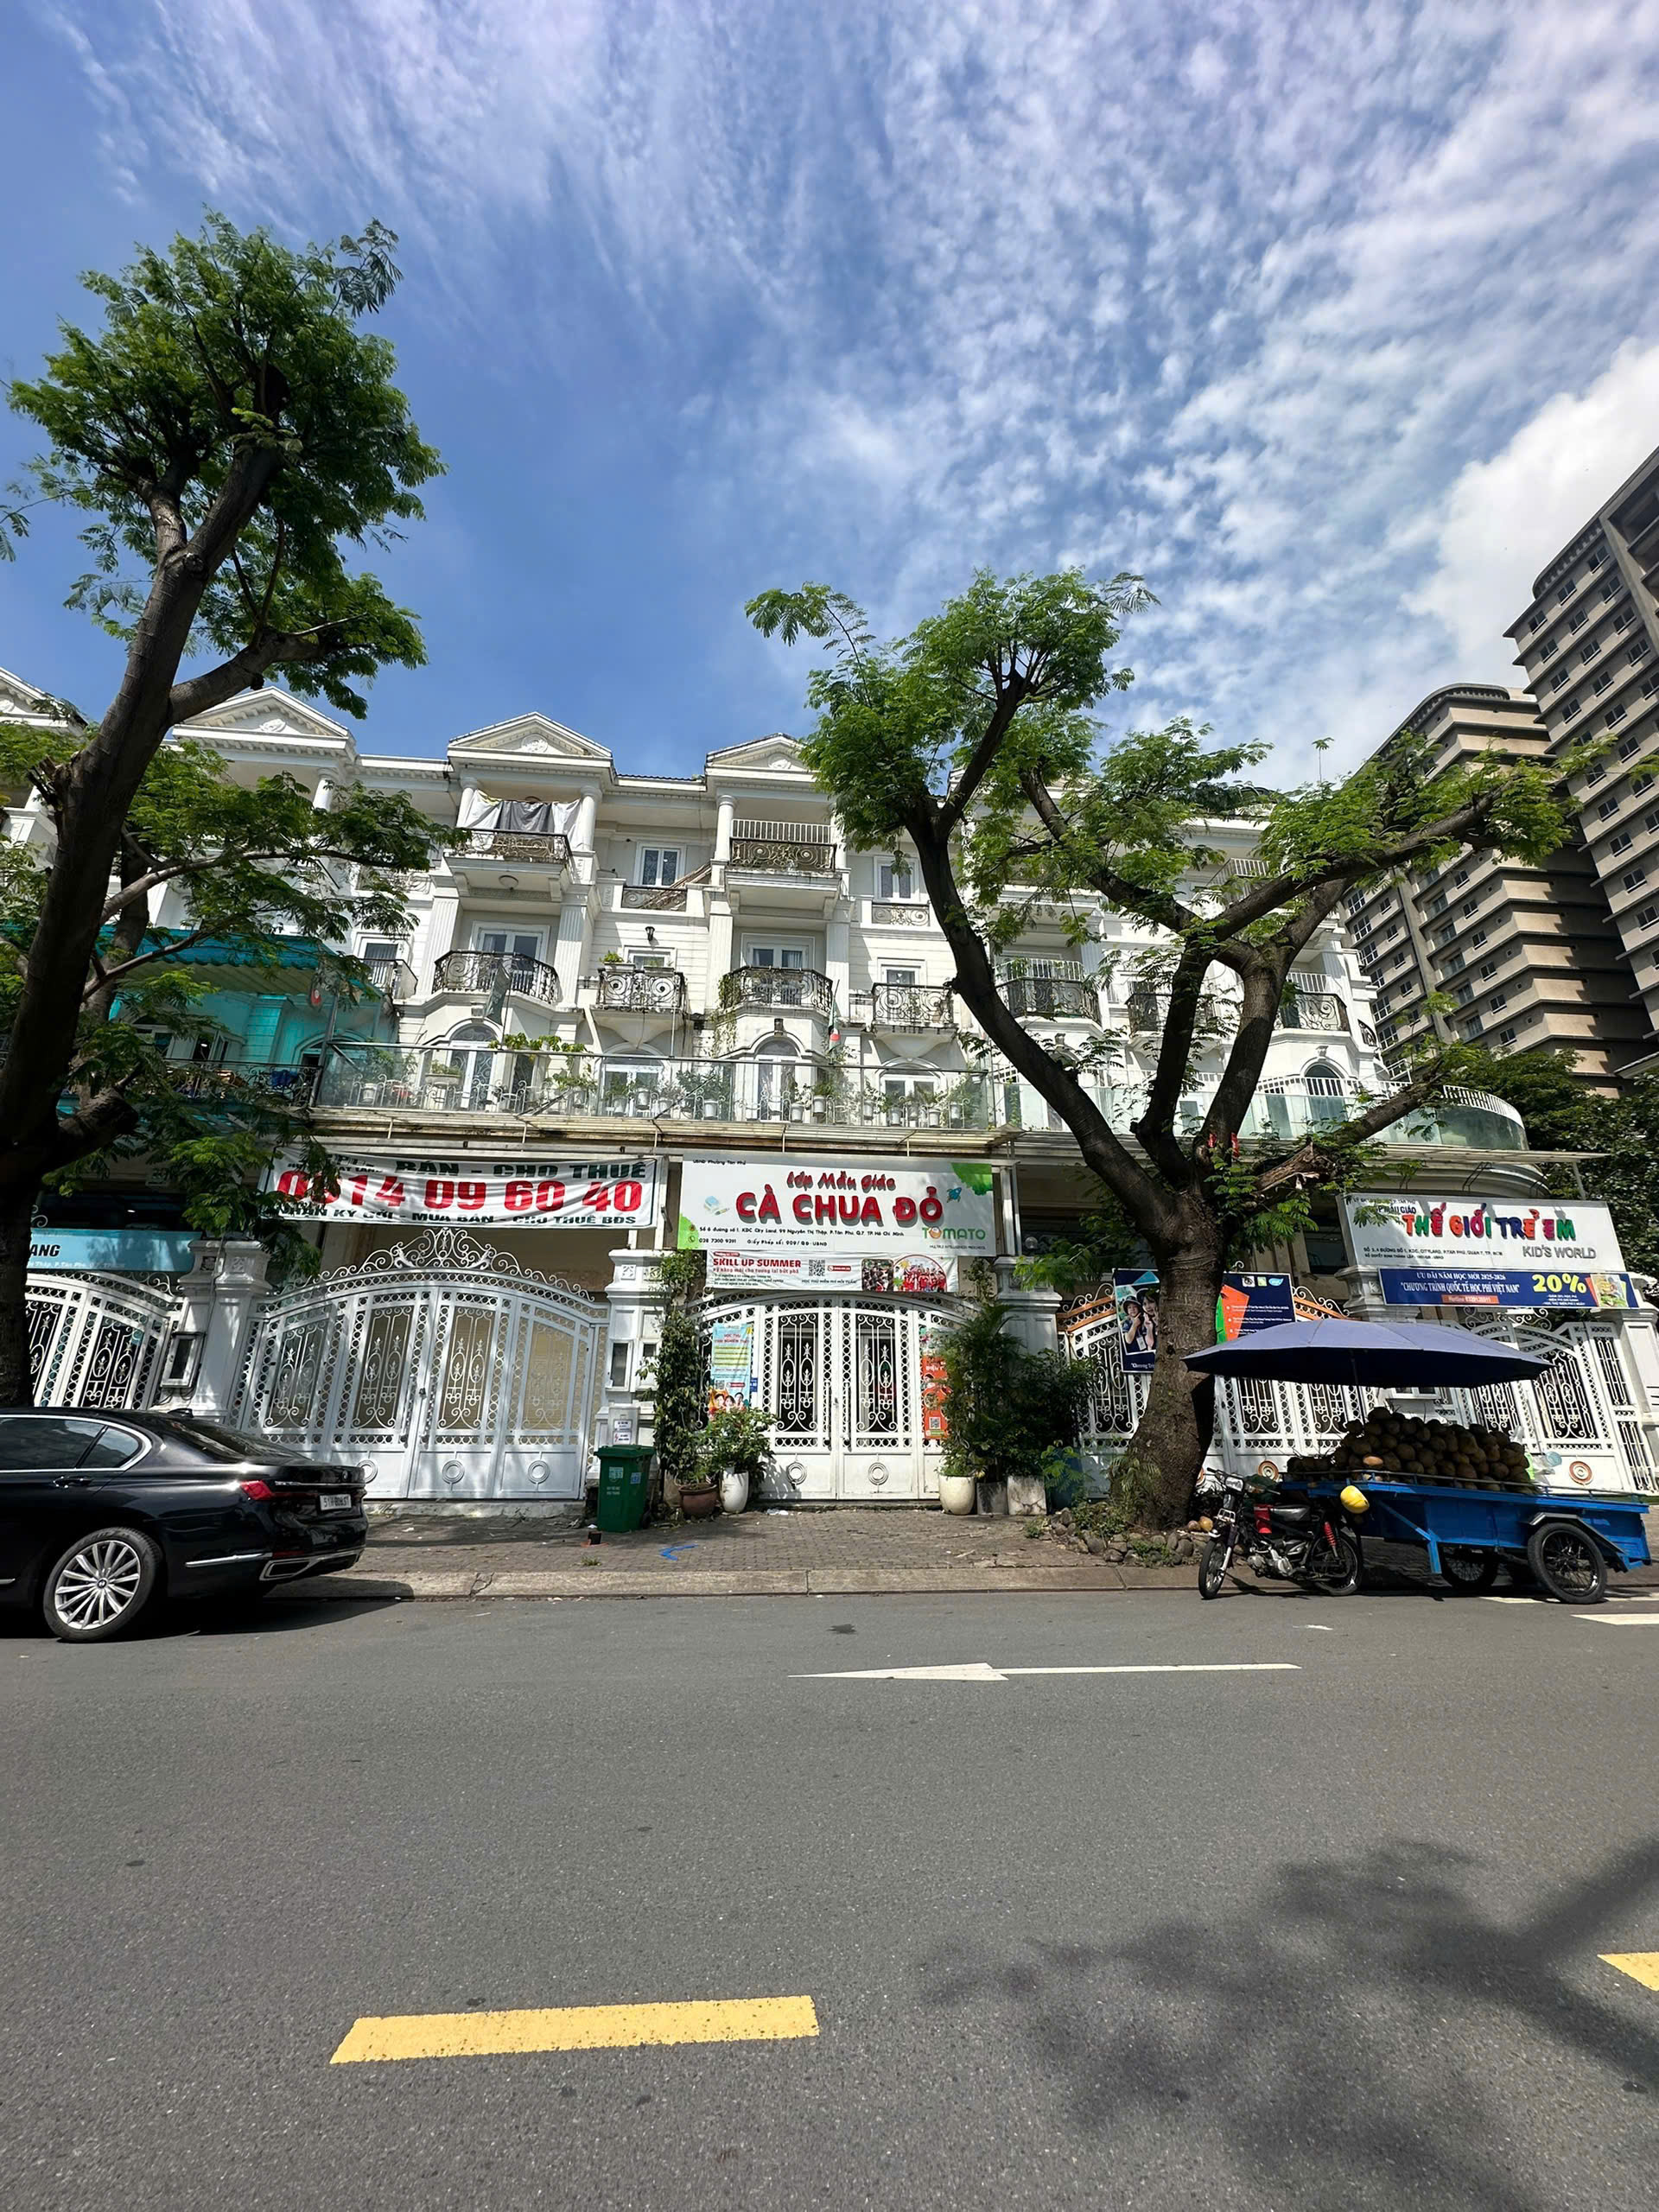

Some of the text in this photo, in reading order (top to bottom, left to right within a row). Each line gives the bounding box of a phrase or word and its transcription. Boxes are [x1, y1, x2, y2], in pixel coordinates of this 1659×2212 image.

[395, 1160, 460, 1176] BÁN
[493, 1164, 559, 1178] CHO
[569, 1161, 647, 1179] THUÊ
[817, 1171, 857, 1191] Mẫu
[861, 1173, 897, 1194] Giáo
[423, 1179, 487, 1211] 09
[504, 1179, 566, 1212] 60
[582, 1179, 643, 1212] 40
[735, 1184, 944, 1227] CÀ CHUA ĐỎ
[1400, 1205, 1417, 1214] GIÁO
[411, 1212, 452, 1222] MUA
[553, 1214, 596, 1224] THUÊ
[601, 1215, 637, 1224] BĐS
[1402, 1202, 1577, 1241] THẾ GIỚI TRẺ EM
[922, 1226, 986, 1241] TOMATO
[1522, 1244, 1597, 1259] KID'S WORLD
[713, 1257, 740, 1267] SKILL
[757, 1259, 802, 1268] SUMMER
[1427, 1271, 1438, 1280] ĐÃI
[1439, 1271, 1452, 1280] NĂM
[1467, 1272, 1480, 1281] MỚI
[1531, 1273, 1587, 1294] 20%
[1427, 1281, 1446, 1292] TRÌNH
[1446, 1281, 1462, 1294] QUỐC
[1462, 1281, 1470, 1293] TẾ
[1470, 1283, 1482, 1294] HỌC
[1492, 1281, 1505, 1295] VIỆT
